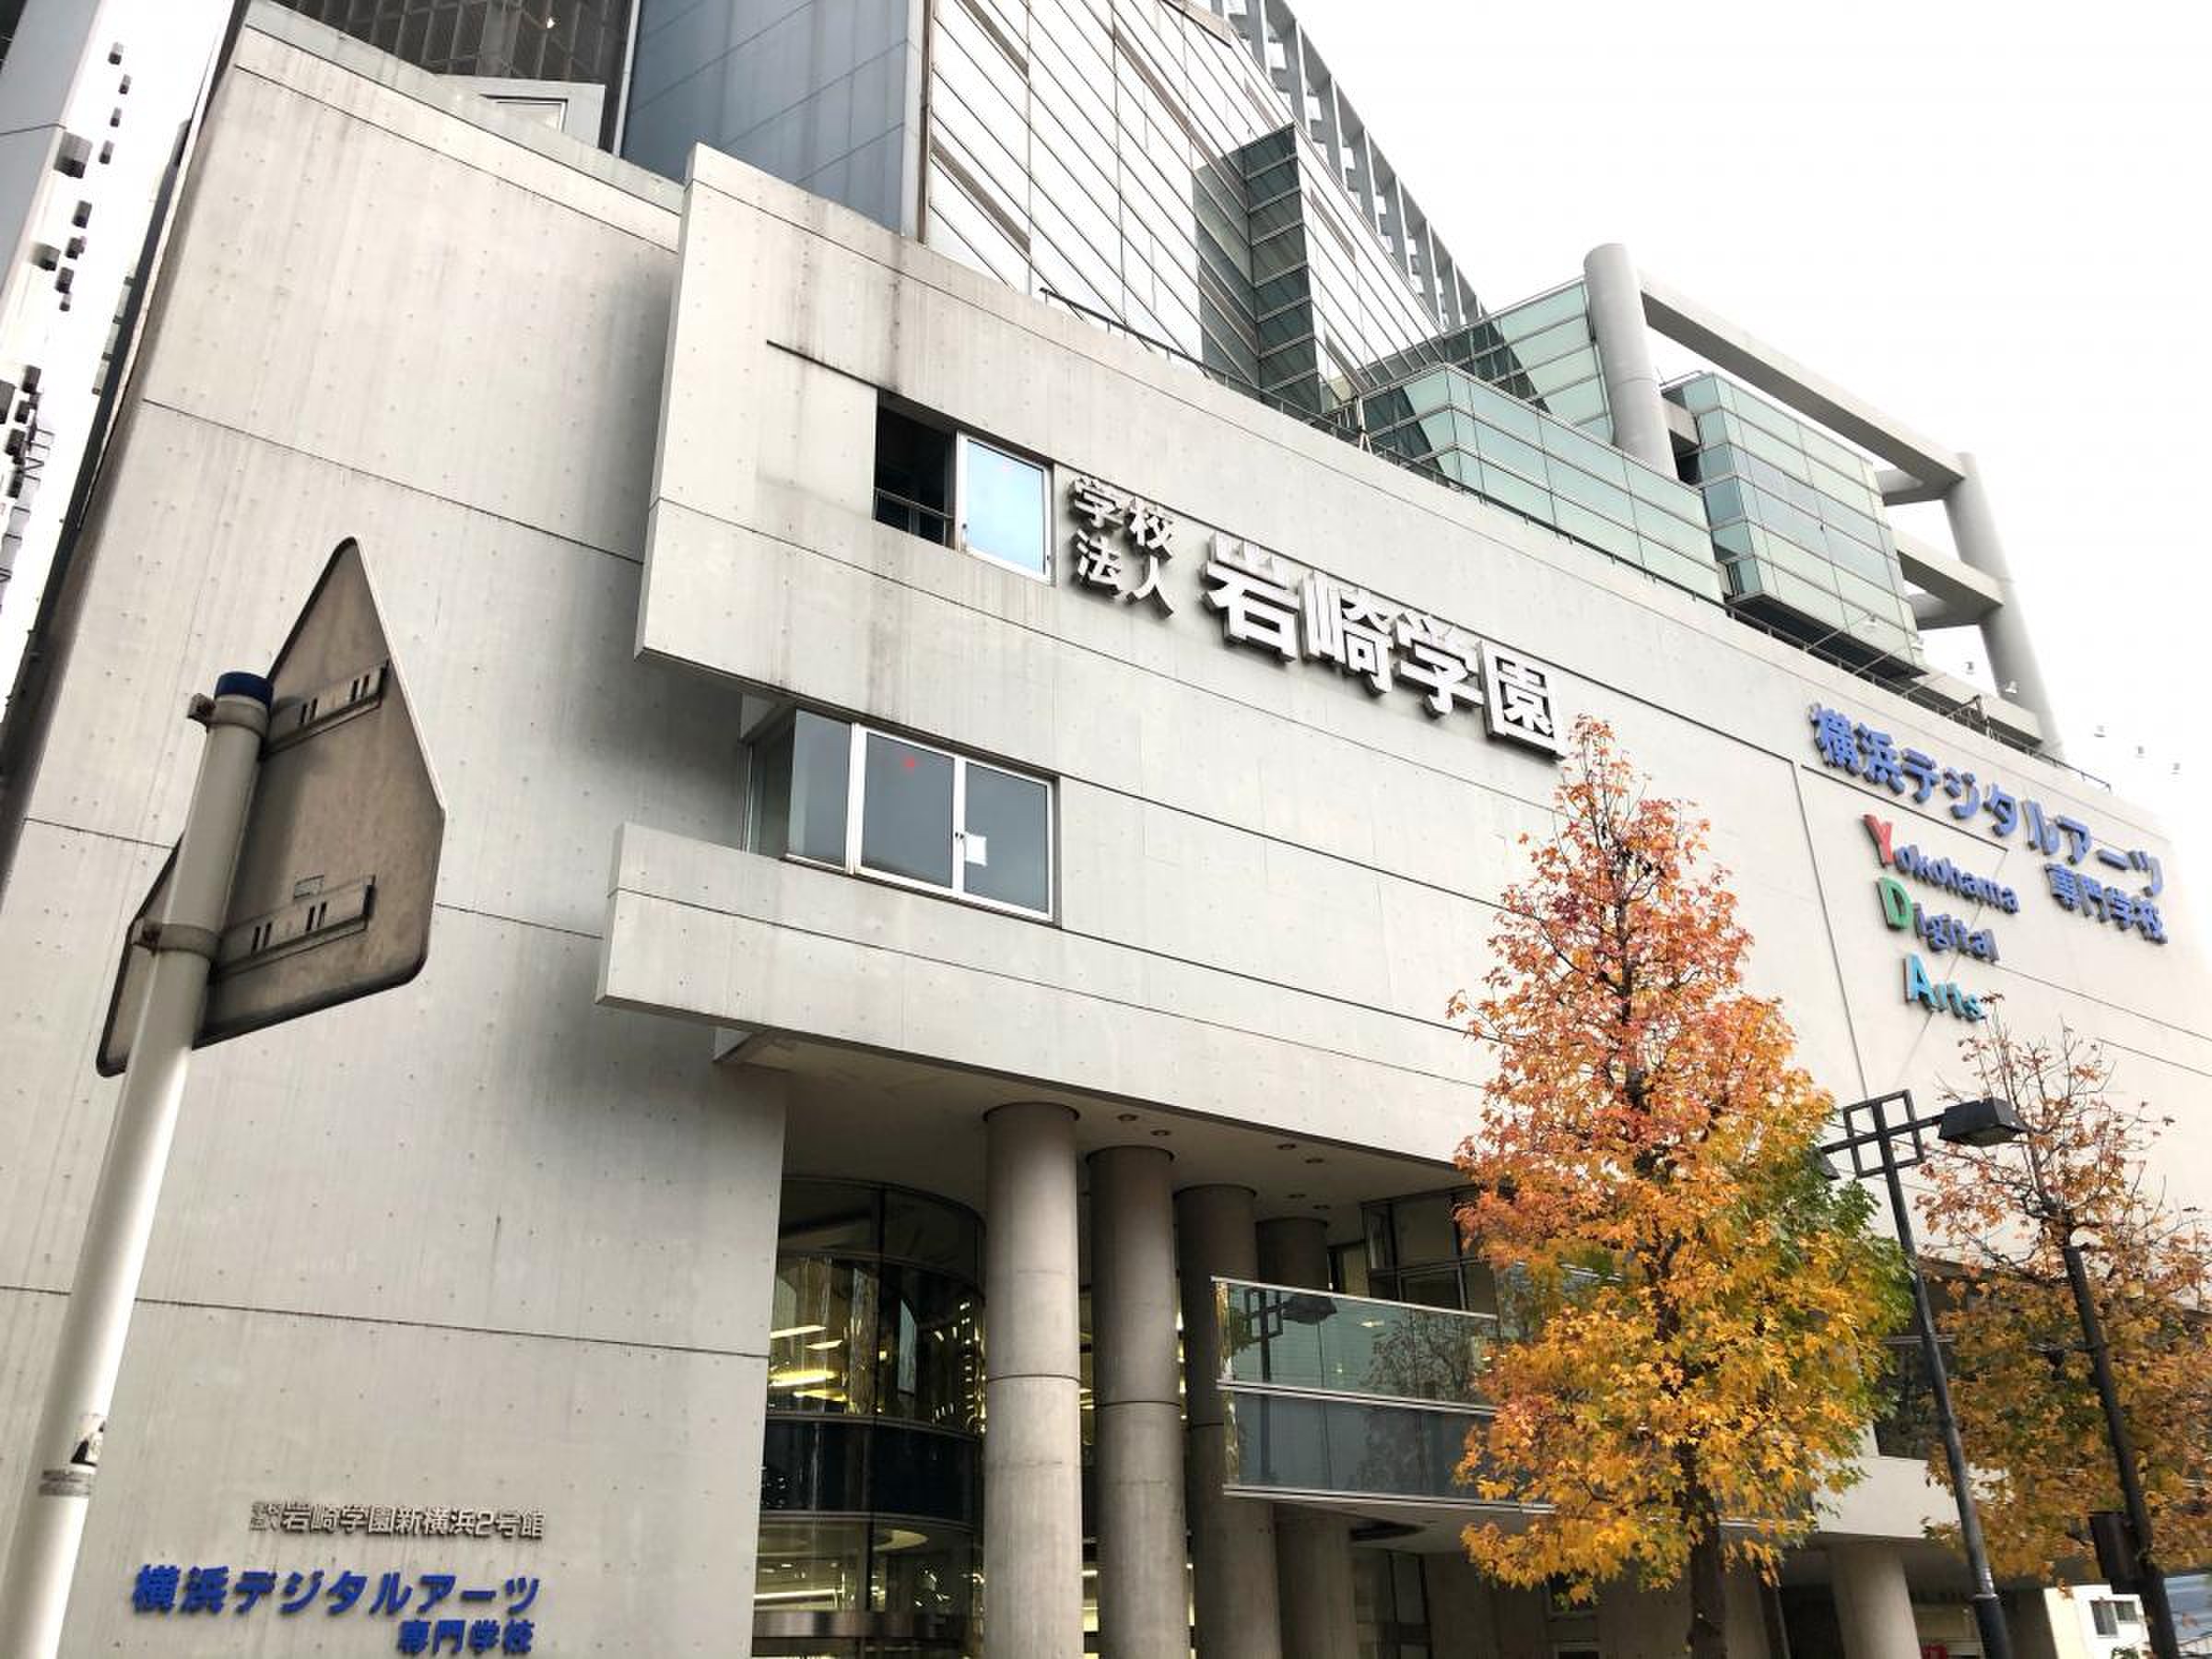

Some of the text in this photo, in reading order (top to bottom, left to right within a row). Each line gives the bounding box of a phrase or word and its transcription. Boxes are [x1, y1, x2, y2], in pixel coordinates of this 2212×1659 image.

[1070, 476, 1173, 563] 学校
[1072, 528, 1175, 619] 法人
[1204, 532, 1566, 761] 岩崎学園
[1809, 703, 2165, 899] 横浜デジタルアーツ
[1860, 814, 2020, 915] Yokohama
[2043, 864, 2169, 945] 専門学校
[1876, 877, 2000, 963] Digital
[1903, 953, 1986, 1022] Arts
[132, 1564, 541, 1616] 横浜デジタルアーツ
[396, 1618, 536, 1656] 専門学校
